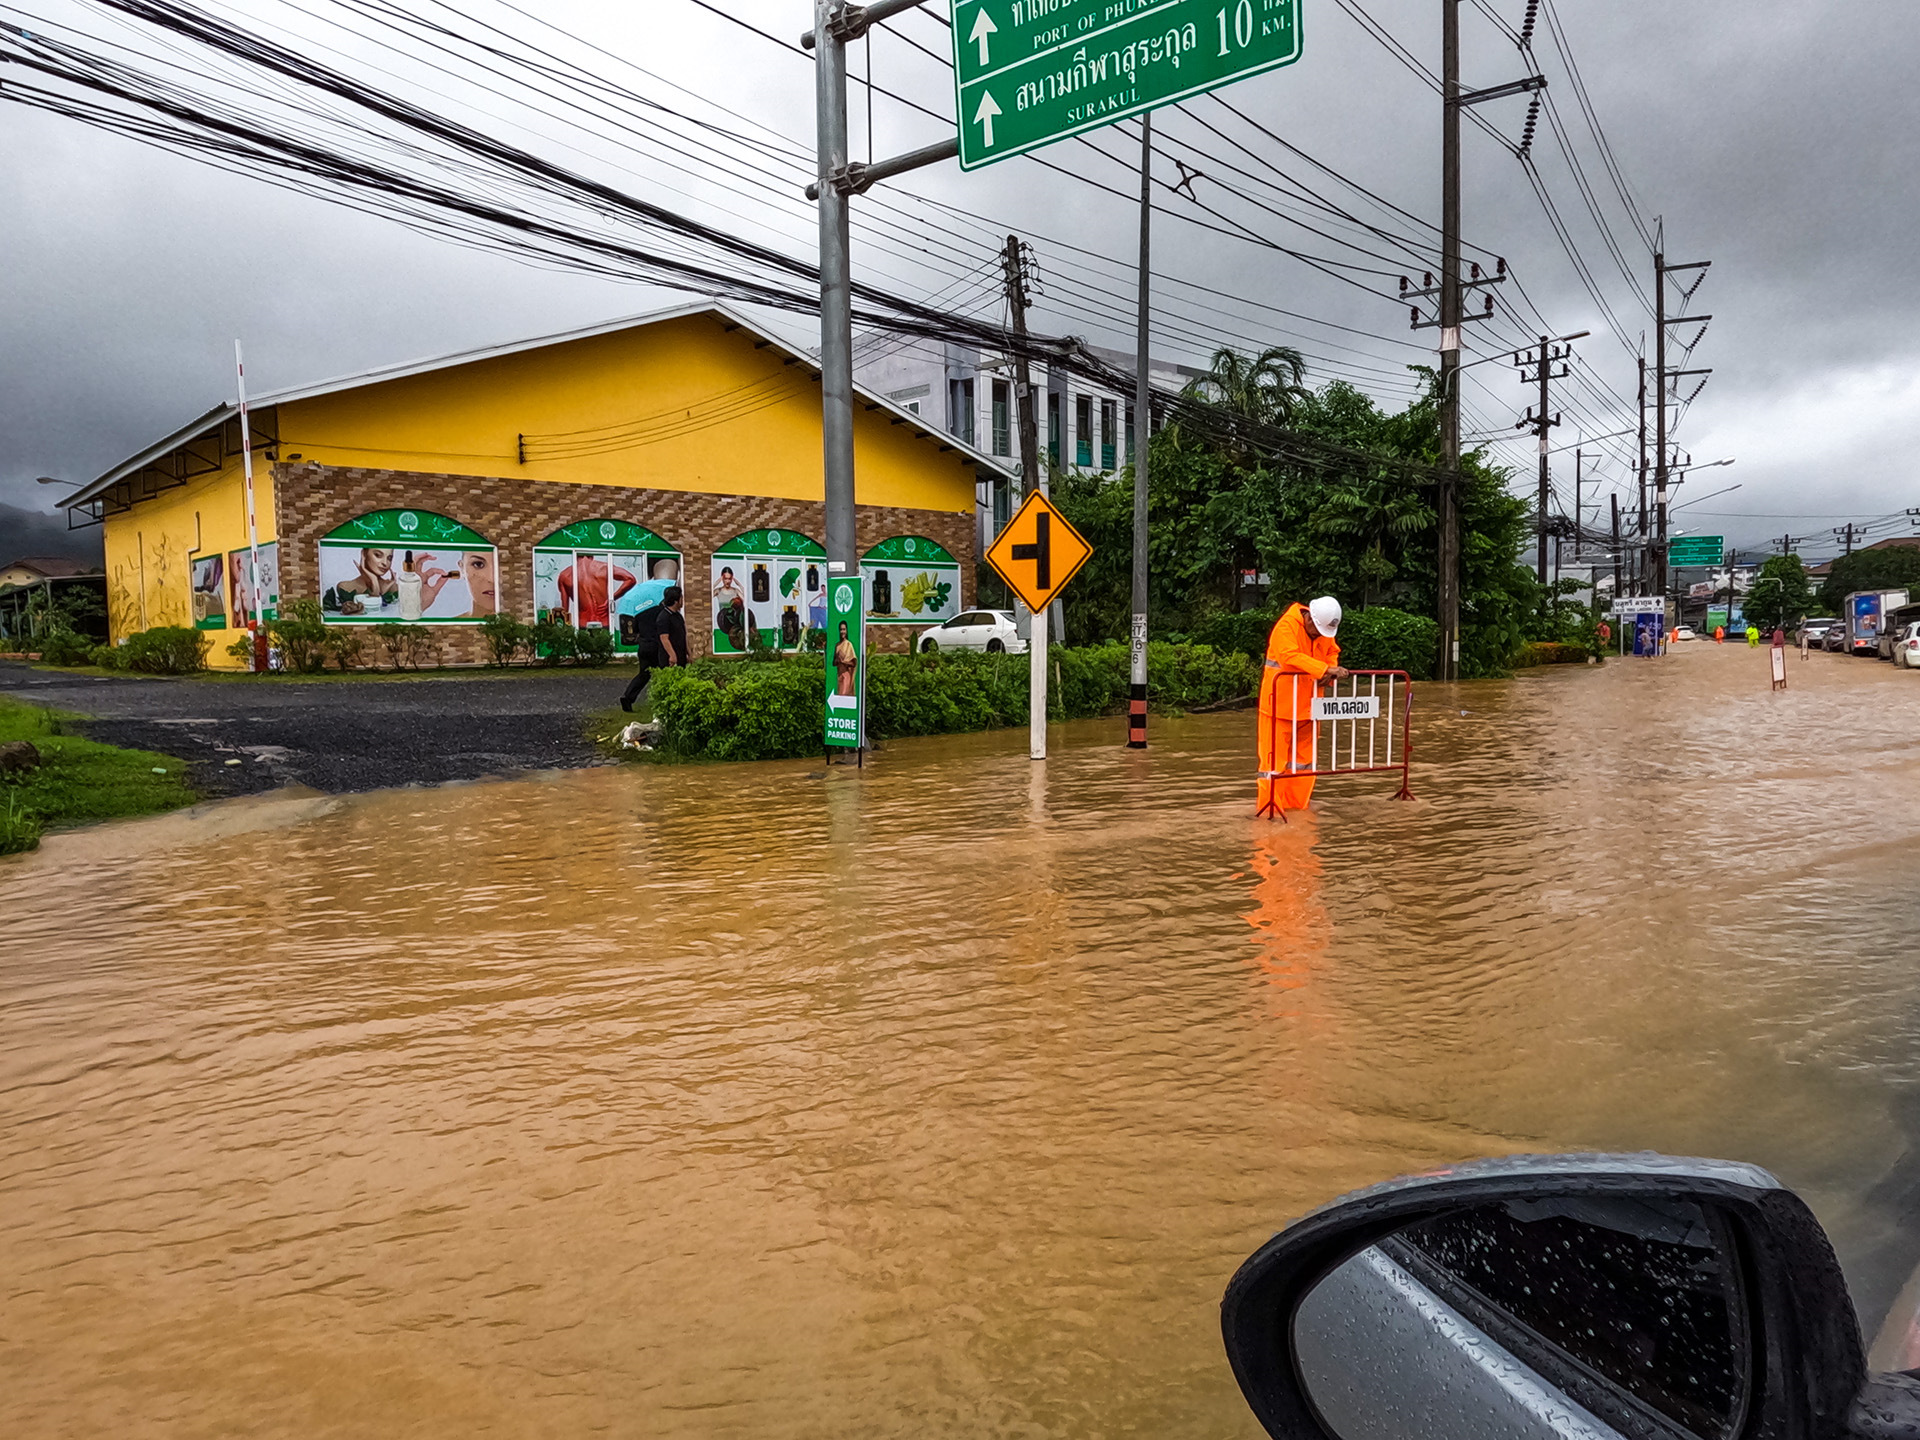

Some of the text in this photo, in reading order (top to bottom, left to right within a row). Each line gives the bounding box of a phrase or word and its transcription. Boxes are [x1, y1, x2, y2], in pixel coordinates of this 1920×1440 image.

[1034, 23, 1070, 49] PORT
[1078, 12, 1097, 31] OF
[1216, 0, 1253, 57] 10
[1262, 15, 1291, 36] KM.
[1016, 22, 1197, 112] สนามกีฬาสุระกุล
[1067, 87, 1141, 124] SURAKUL
[827, 717, 857, 730] STORE
[827, 730, 857, 741] PARKING
